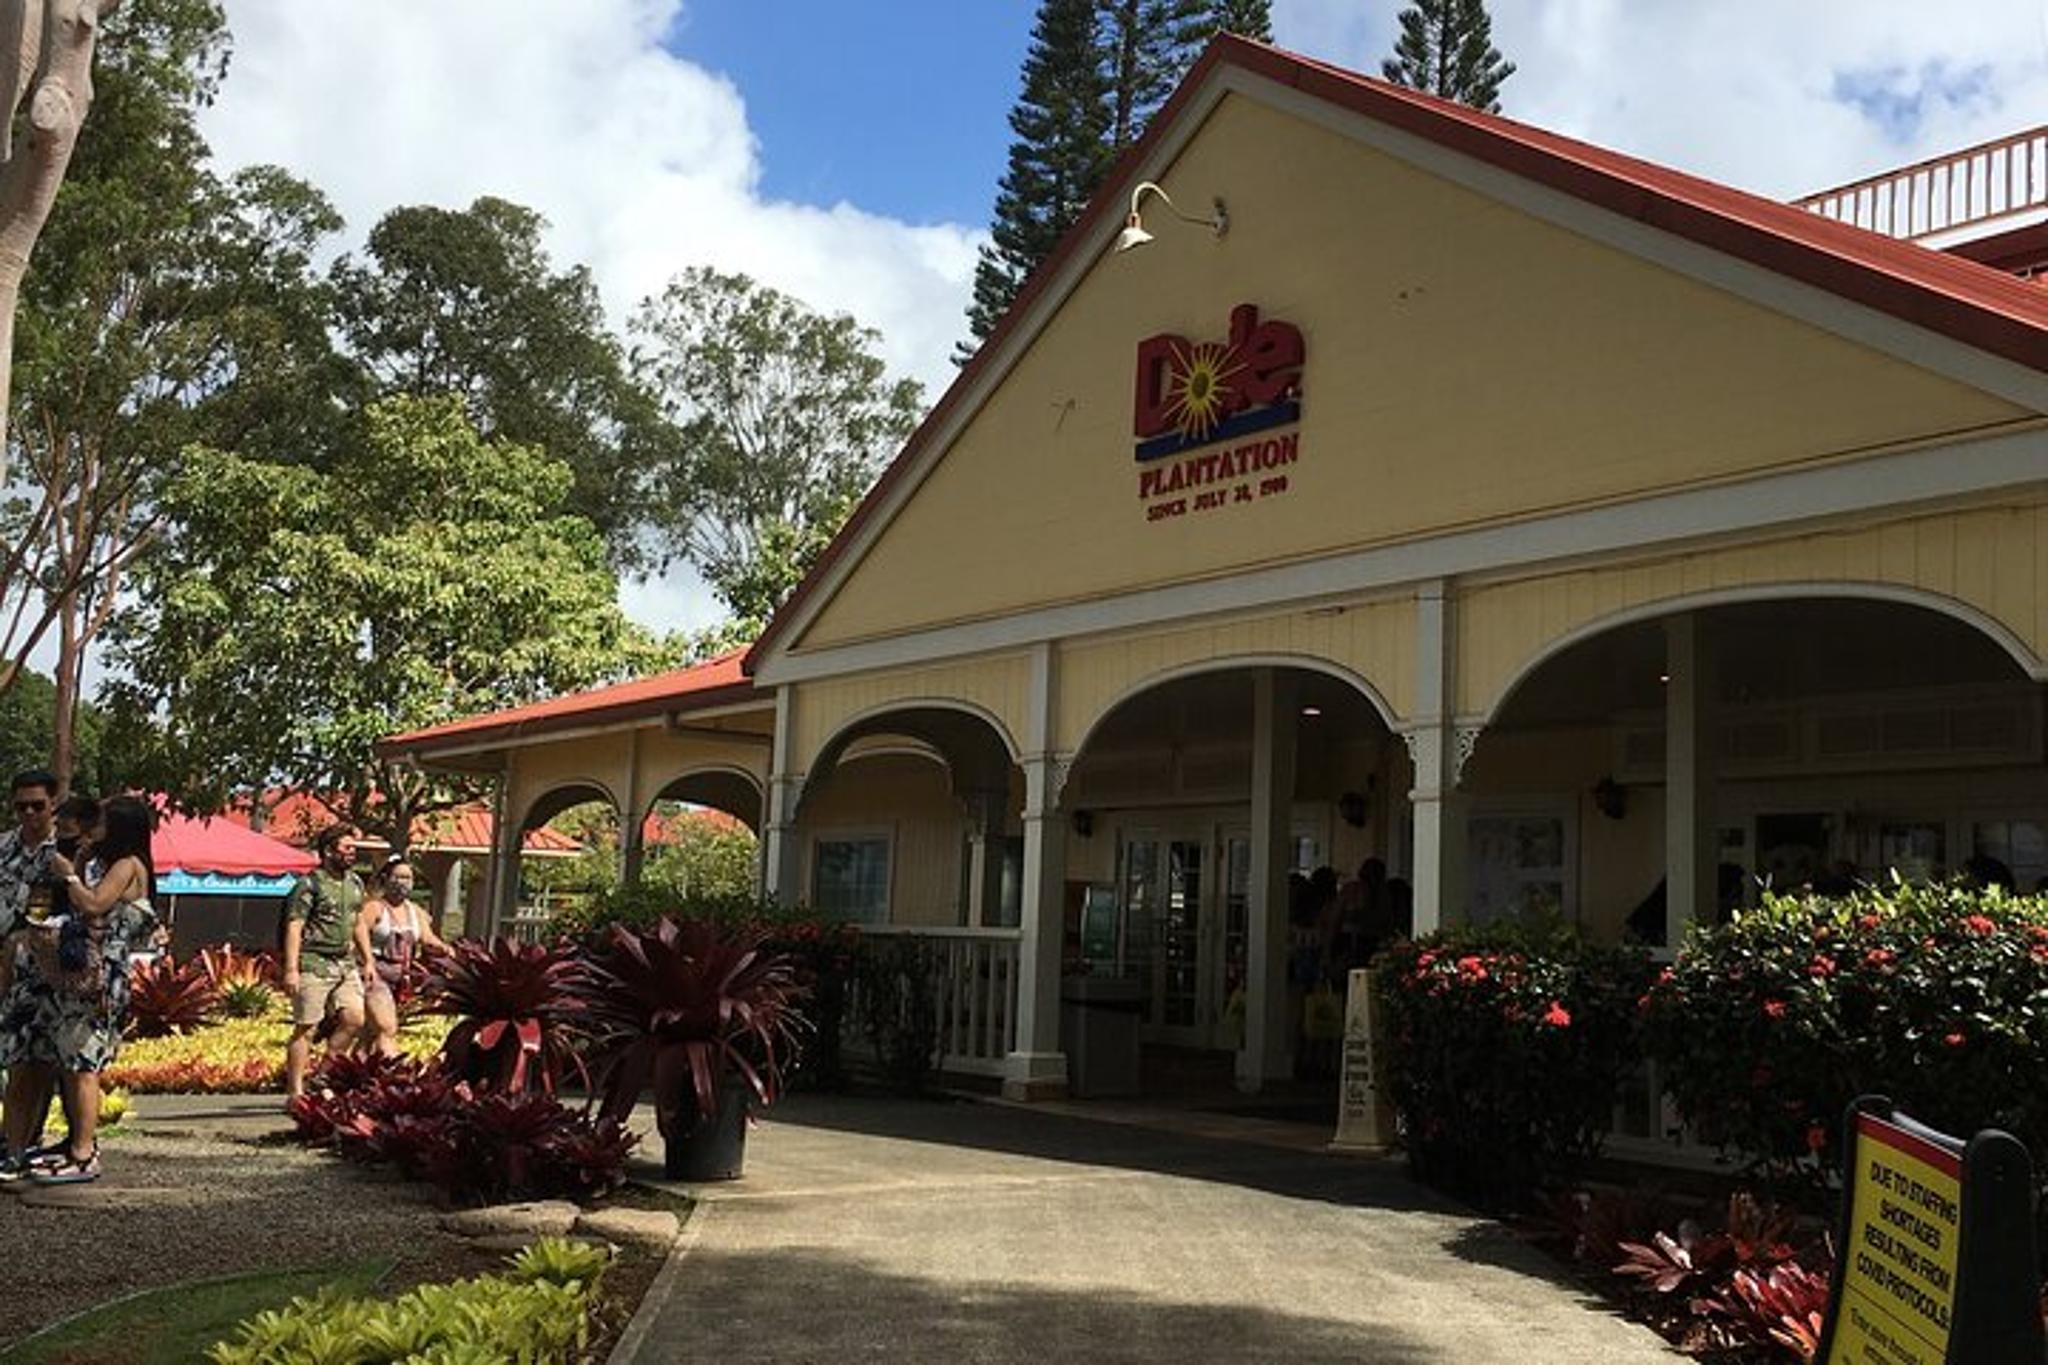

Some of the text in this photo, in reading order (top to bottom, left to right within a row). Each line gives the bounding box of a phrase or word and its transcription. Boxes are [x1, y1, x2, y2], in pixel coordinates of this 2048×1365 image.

[1134, 303, 1306, 439] Dole
[1138, 433, 1300, 500] PLANTATION
[1146, 498, 1187, 523] SINCE
[1193, 489, 1227, 512] JULY
[1870, 1160, 1958, 1225] DUE TO STAFFING
[1879, 1199, 1942, 1251] SHORTAGES
[1856, 1251, 1886, 1285] COVID
[1864, 1223, 1952, 1294] RESULTING FROM
